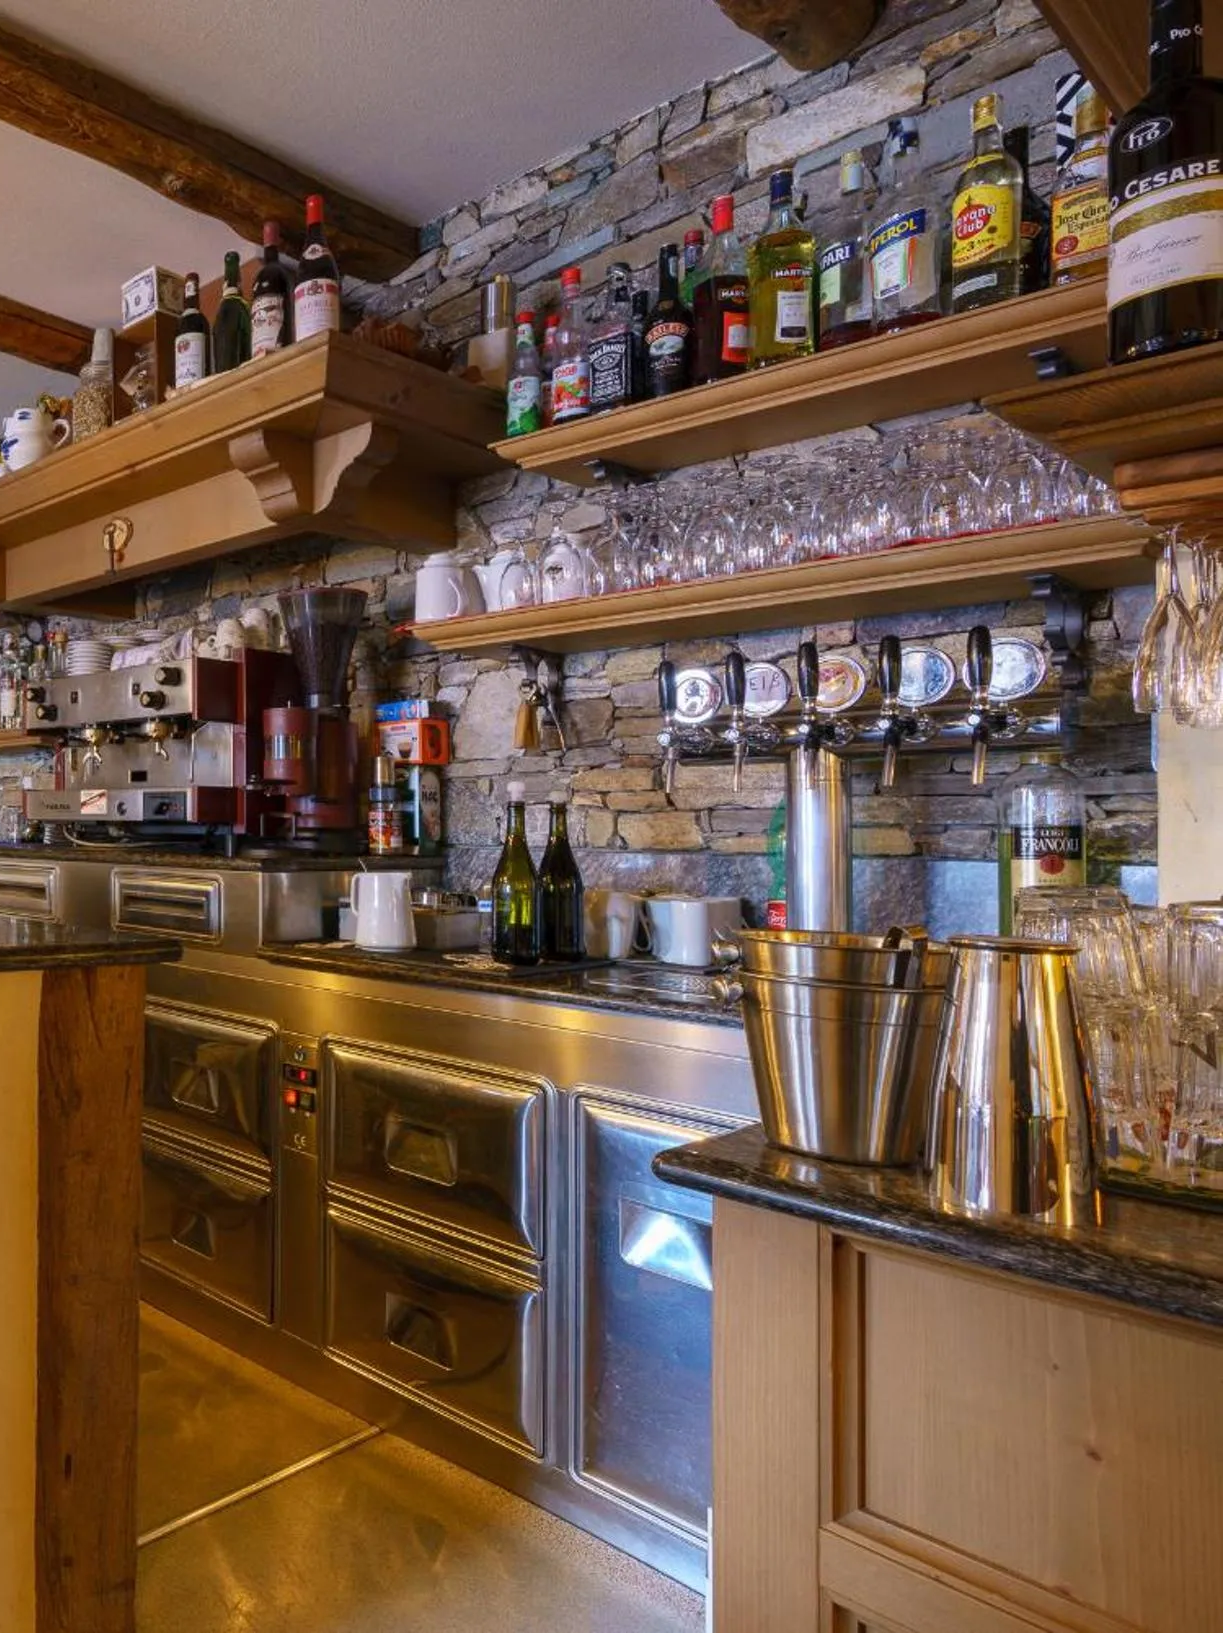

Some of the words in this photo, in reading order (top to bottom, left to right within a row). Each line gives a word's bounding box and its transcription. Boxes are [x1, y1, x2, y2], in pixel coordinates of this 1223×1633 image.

[1124, 159, 1220, 200] CESARE
[957, 204, 996, 226] avana
[871, 219, 917, 253] PEROL
[822, 245, 851, 270] PARI
